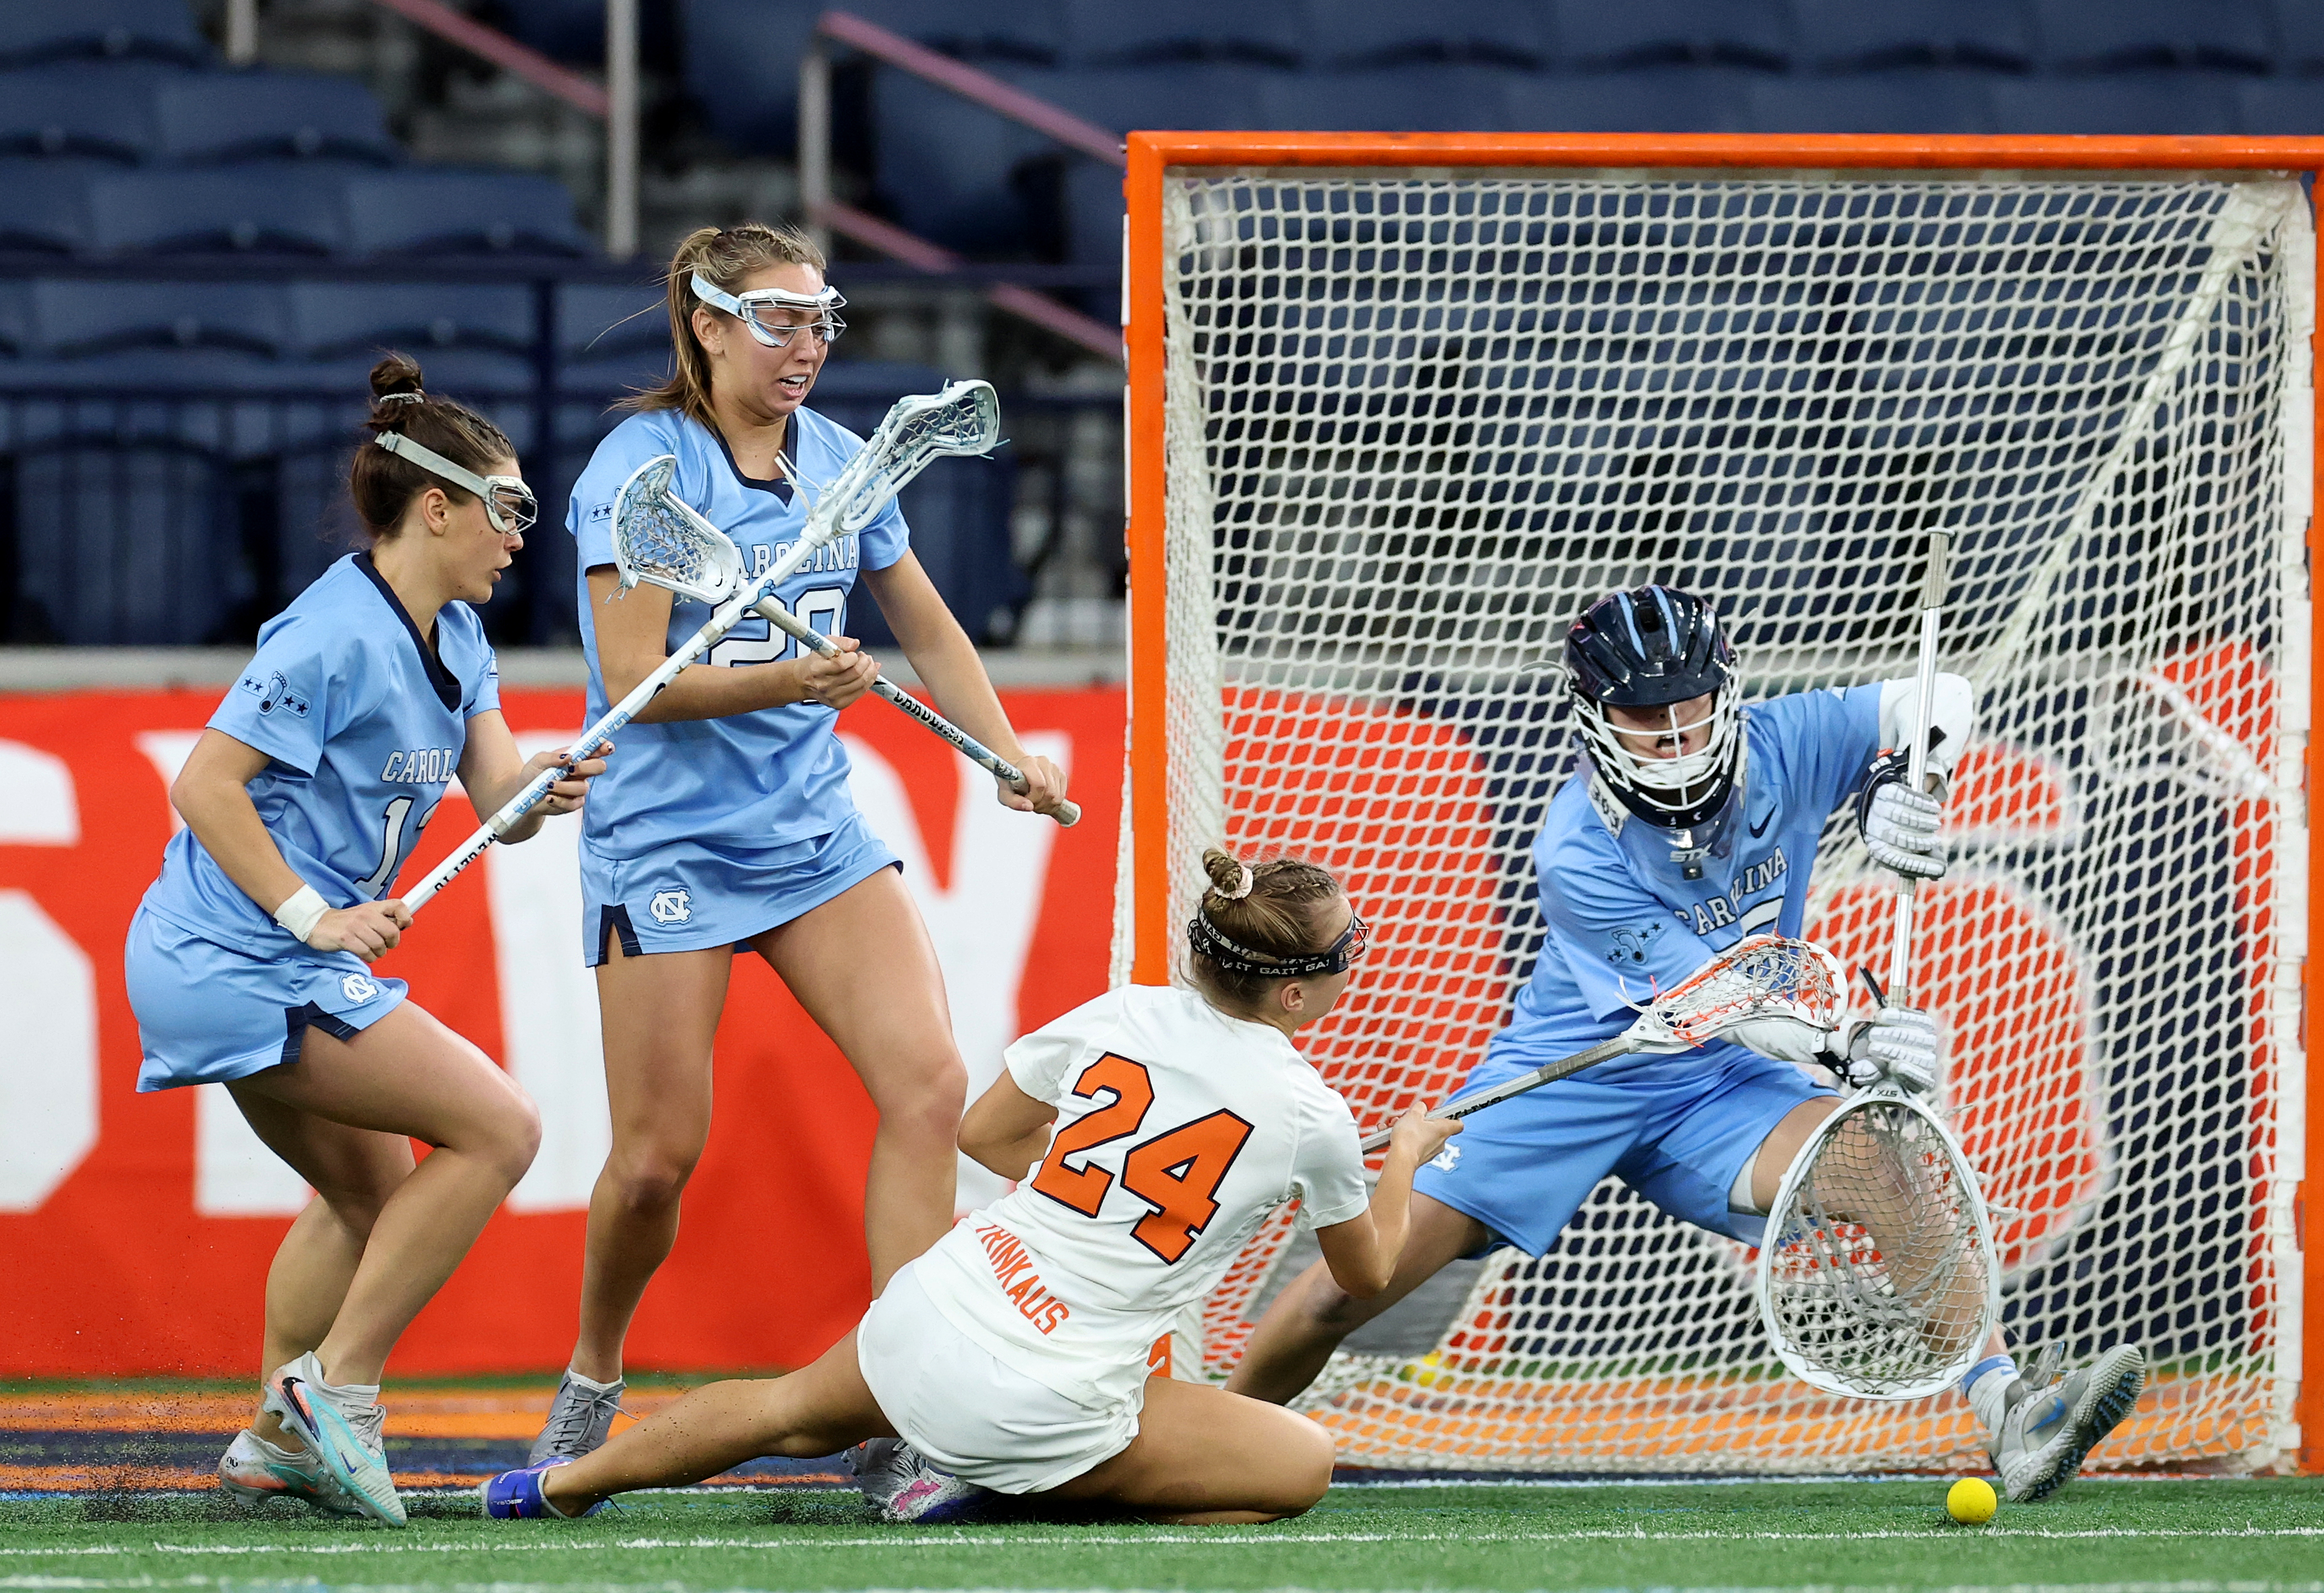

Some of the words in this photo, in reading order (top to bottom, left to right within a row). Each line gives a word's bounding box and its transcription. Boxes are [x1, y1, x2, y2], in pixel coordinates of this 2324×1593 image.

[708, 586, 847, 705] 20
[352, 795, 443, 901] 1
[1669, 843, 1712, 862] STX
[1877, 1089, 1898, 1097] STX
[1030, 1051, 1255, 1266] 24
[975, 1224, 1070, 1336] TRINKAUS
